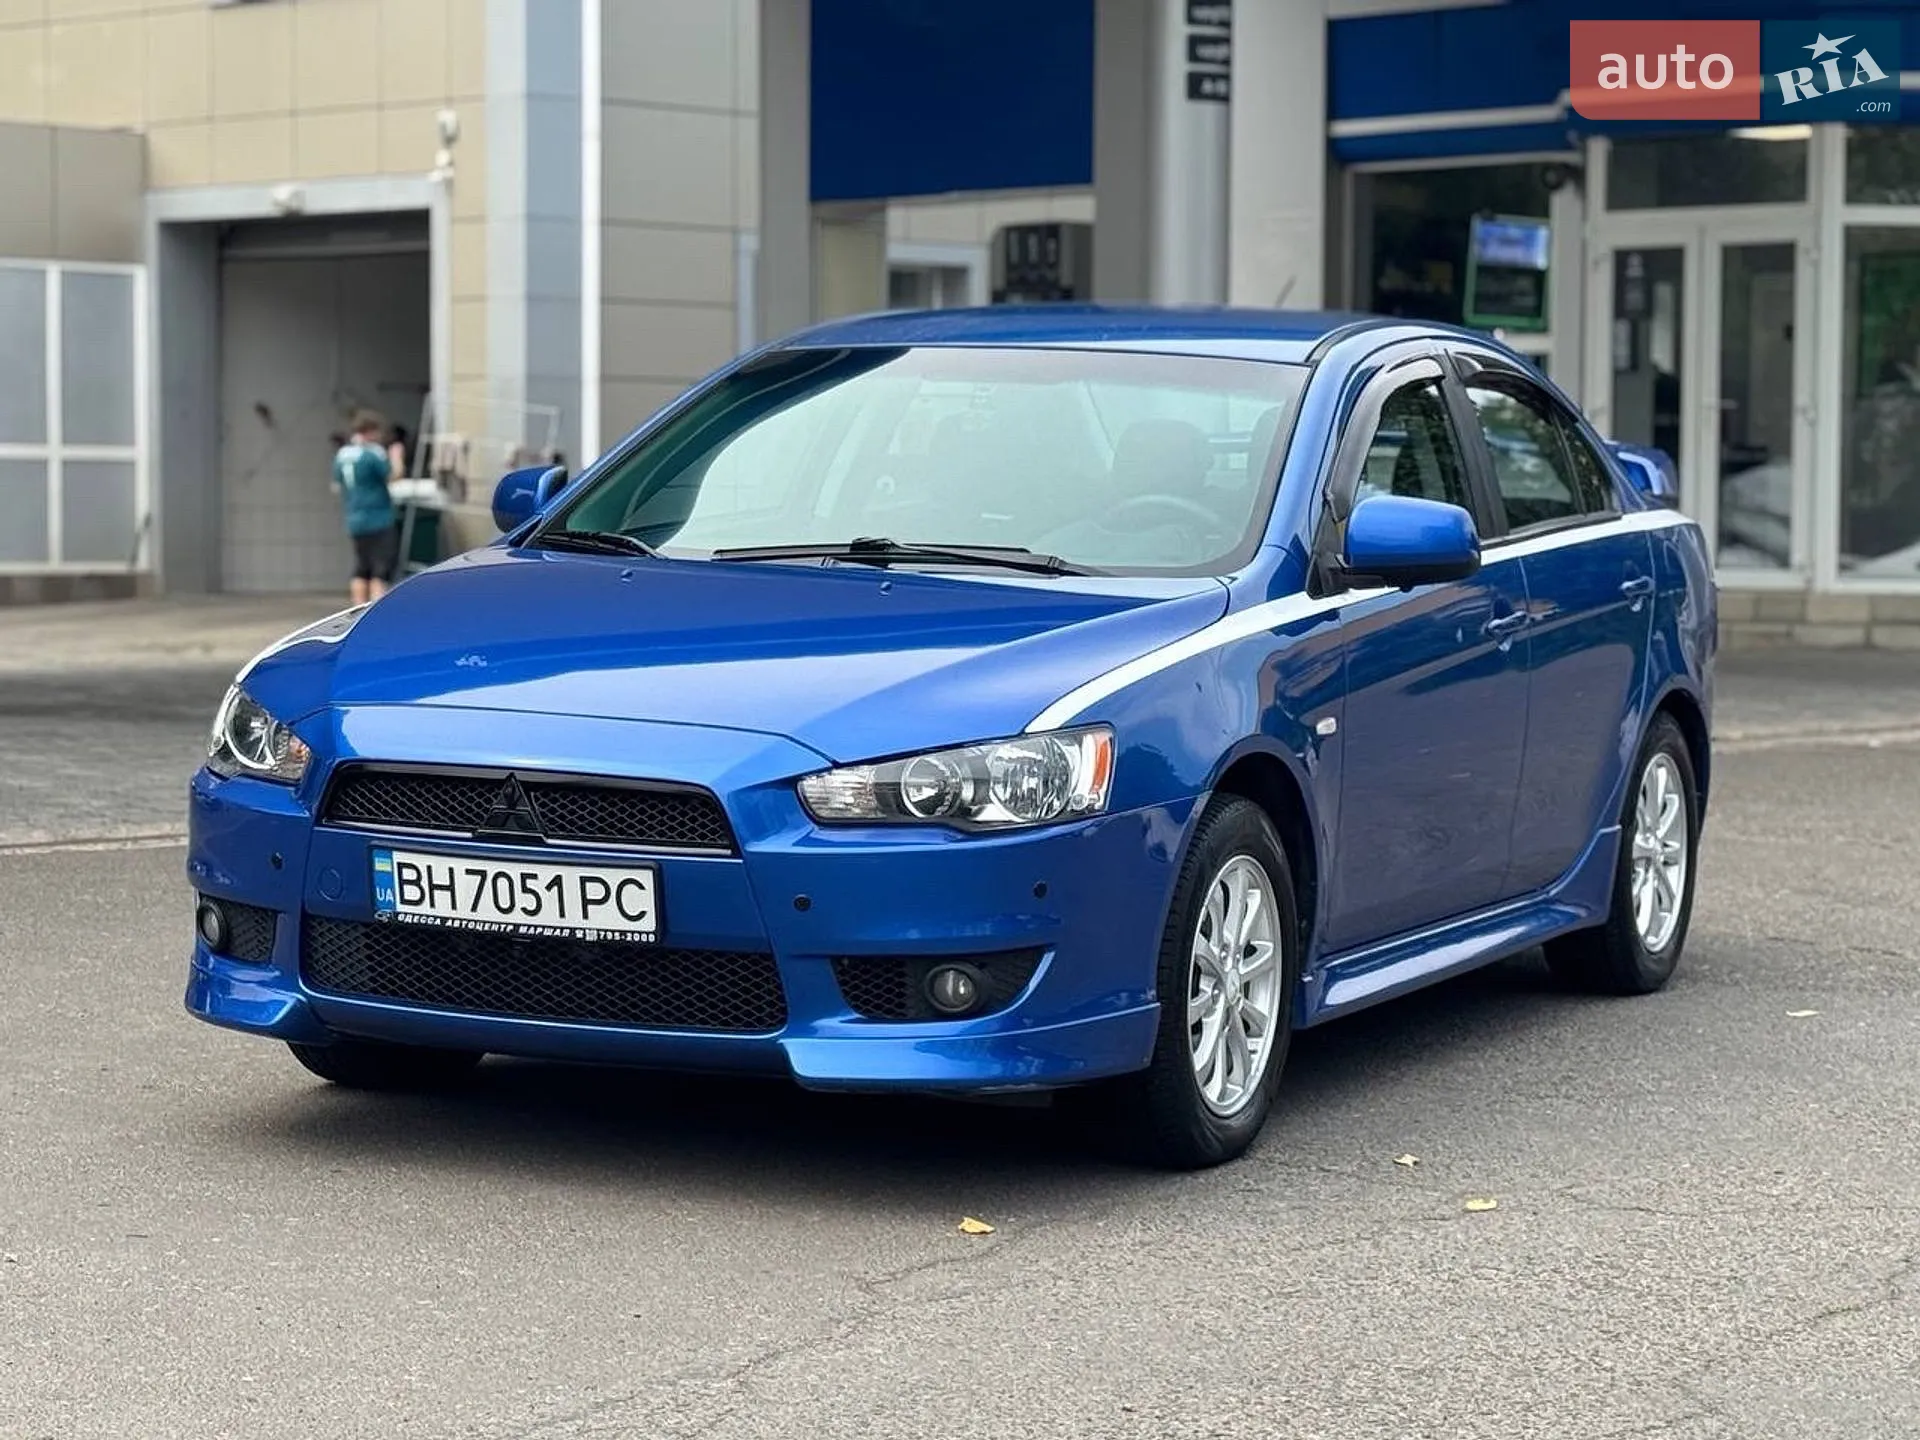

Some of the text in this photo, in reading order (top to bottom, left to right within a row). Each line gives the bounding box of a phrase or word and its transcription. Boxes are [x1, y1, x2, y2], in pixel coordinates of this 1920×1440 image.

[376, 887, 394, 902] UA
[397, 861, 648, 923] BH 7051 PC
[397, 912, 442, 925] ОДЕССА
[445, 918, 515, 933] АВТОЦЕНТР
